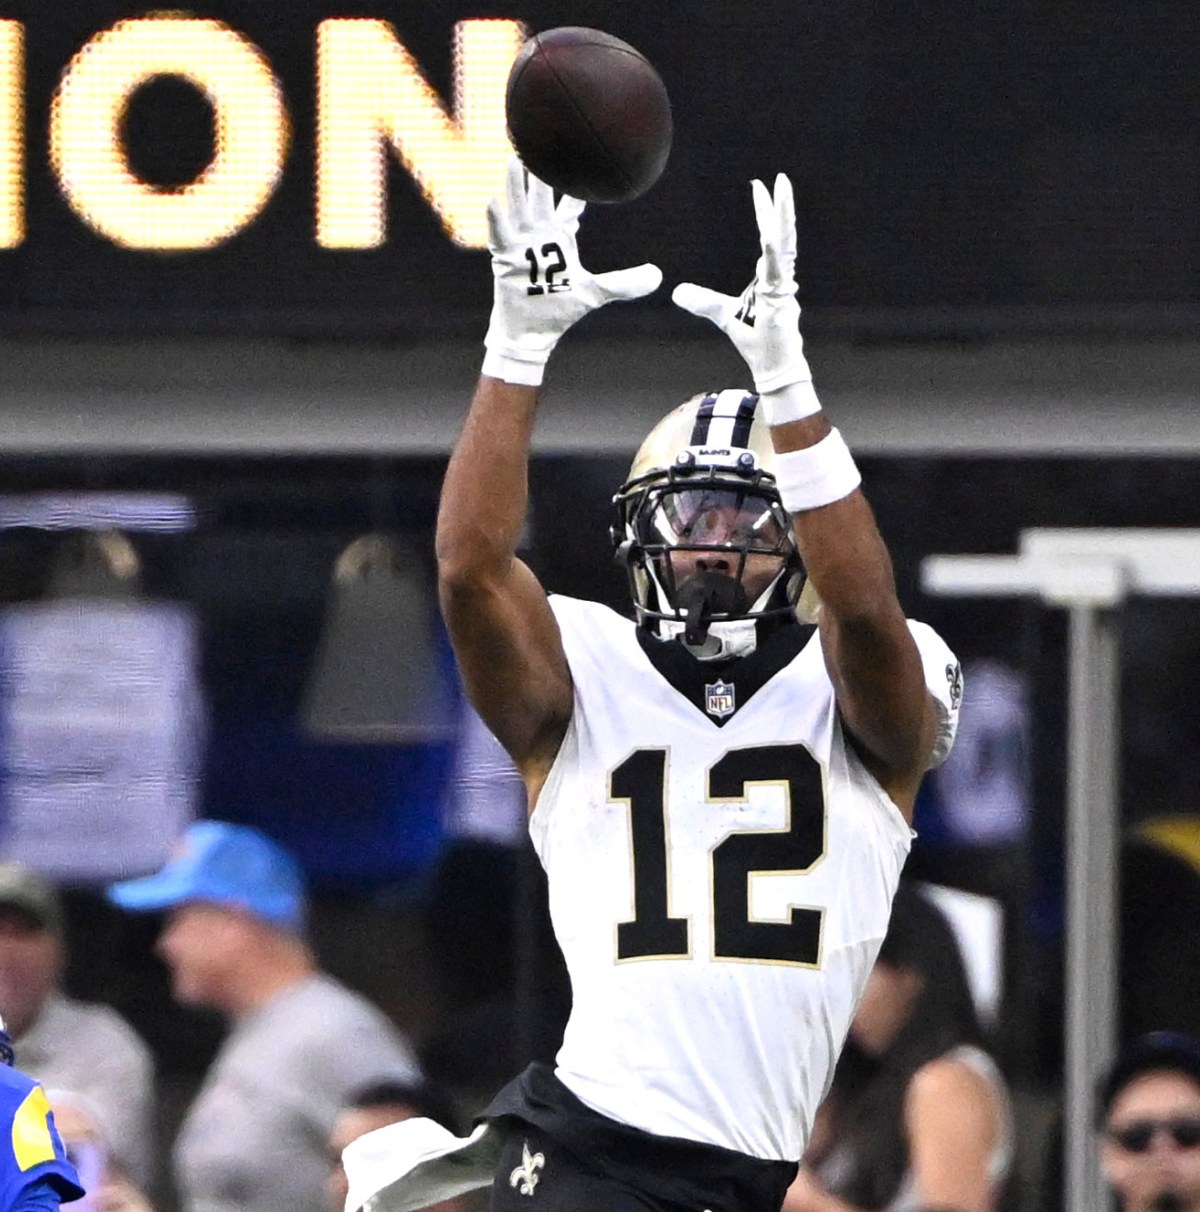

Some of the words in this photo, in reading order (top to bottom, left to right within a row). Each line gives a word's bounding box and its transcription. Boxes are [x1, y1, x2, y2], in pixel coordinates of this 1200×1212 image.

[524, 241, 572, 296] 12
[710, 696, 735, 713] NFL
[606, 739, 829, 970] 12
